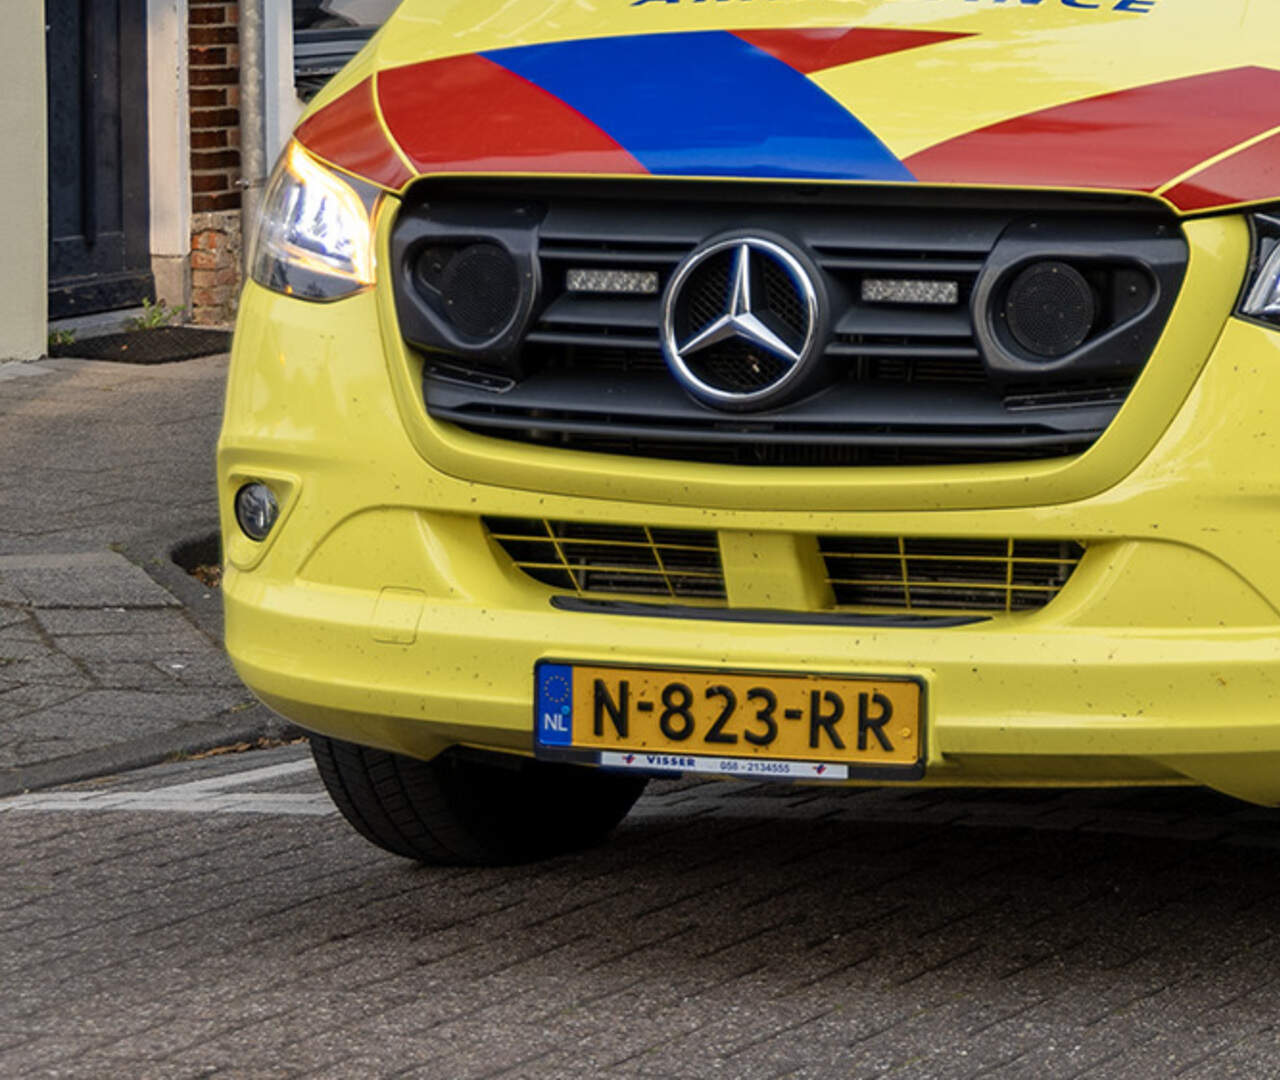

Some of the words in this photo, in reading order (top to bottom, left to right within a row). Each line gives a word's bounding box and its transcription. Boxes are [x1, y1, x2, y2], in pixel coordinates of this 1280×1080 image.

[544, 713, 568, 732] NL
[592, 678, 895, 752] N-823-RR
[646, 755, 696, 768] VISSER
